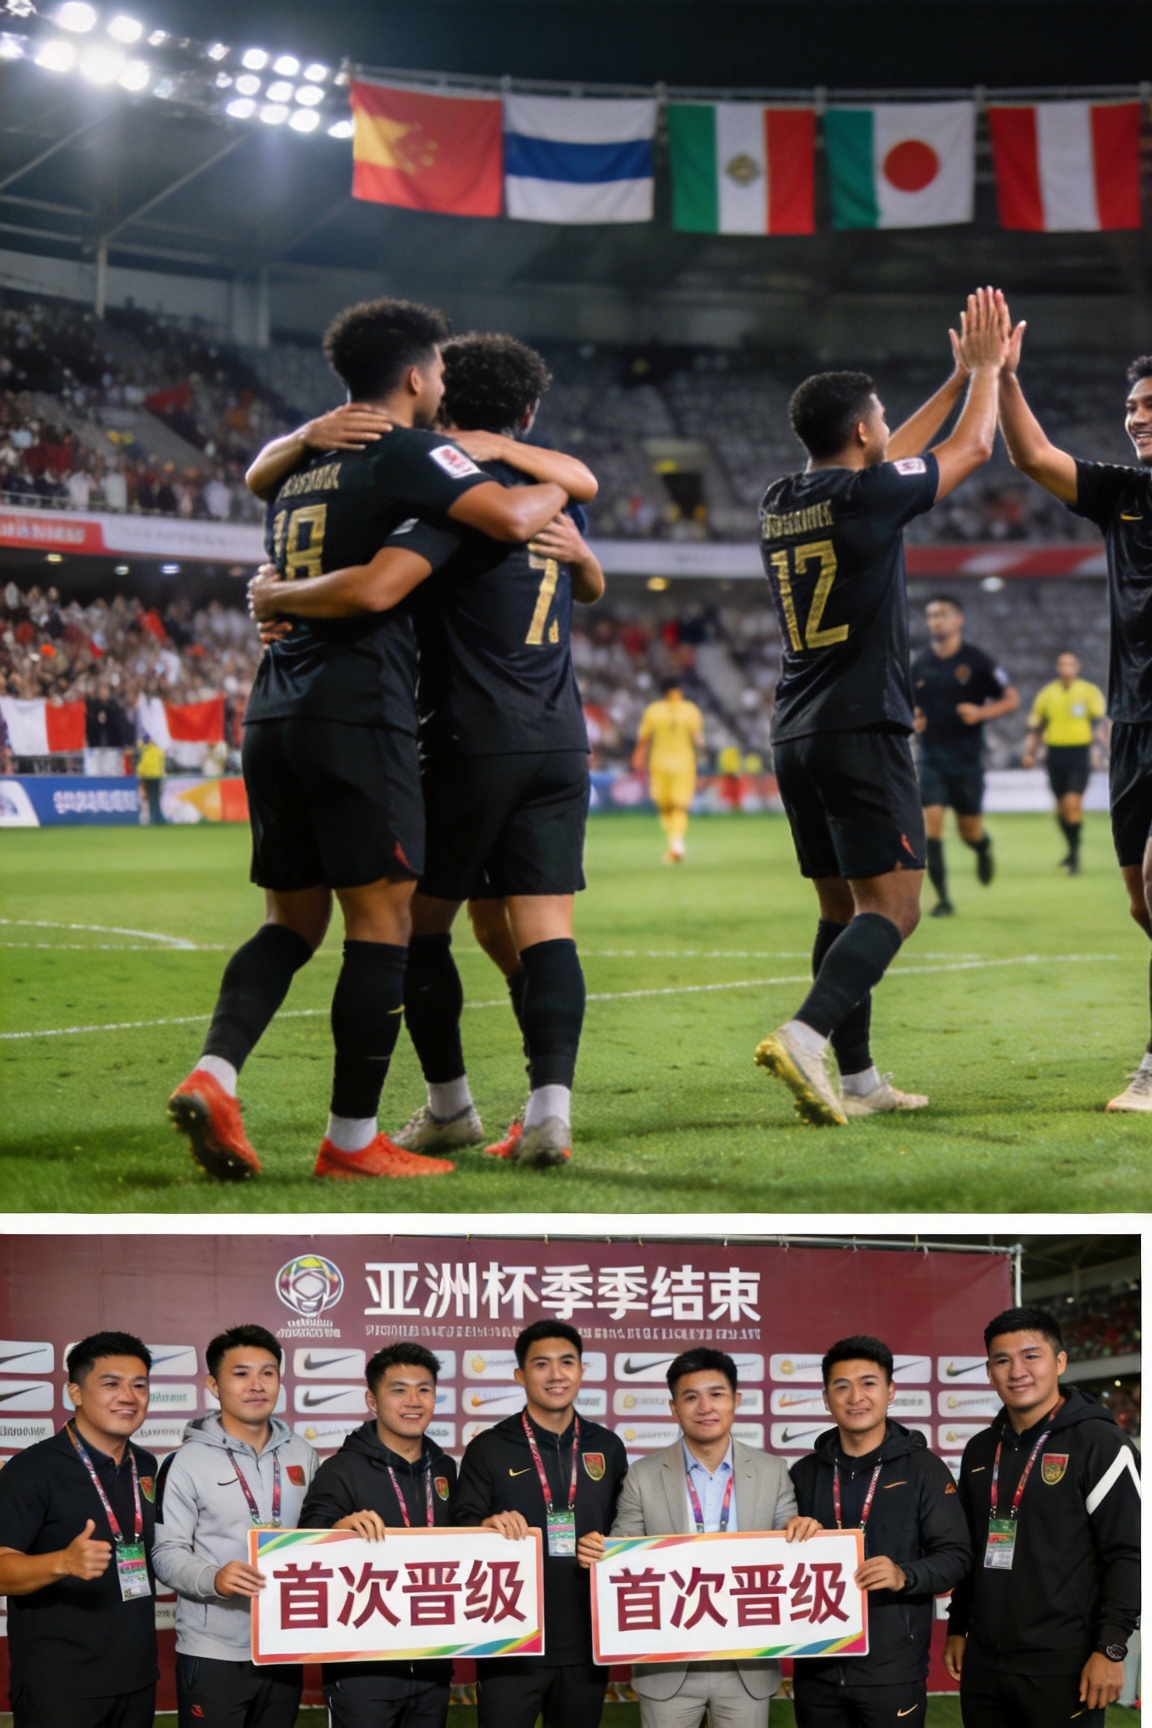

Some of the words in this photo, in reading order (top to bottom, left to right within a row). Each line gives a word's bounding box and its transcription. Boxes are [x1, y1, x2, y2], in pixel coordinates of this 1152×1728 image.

[770, 540, 849, 652] 12
[363, 1262, 762, 1322] 亚洲杯季季结束
[273, 1559, 527, 1630] 首次晋级
[609, 1562, 850, 1632] 首次晋级
